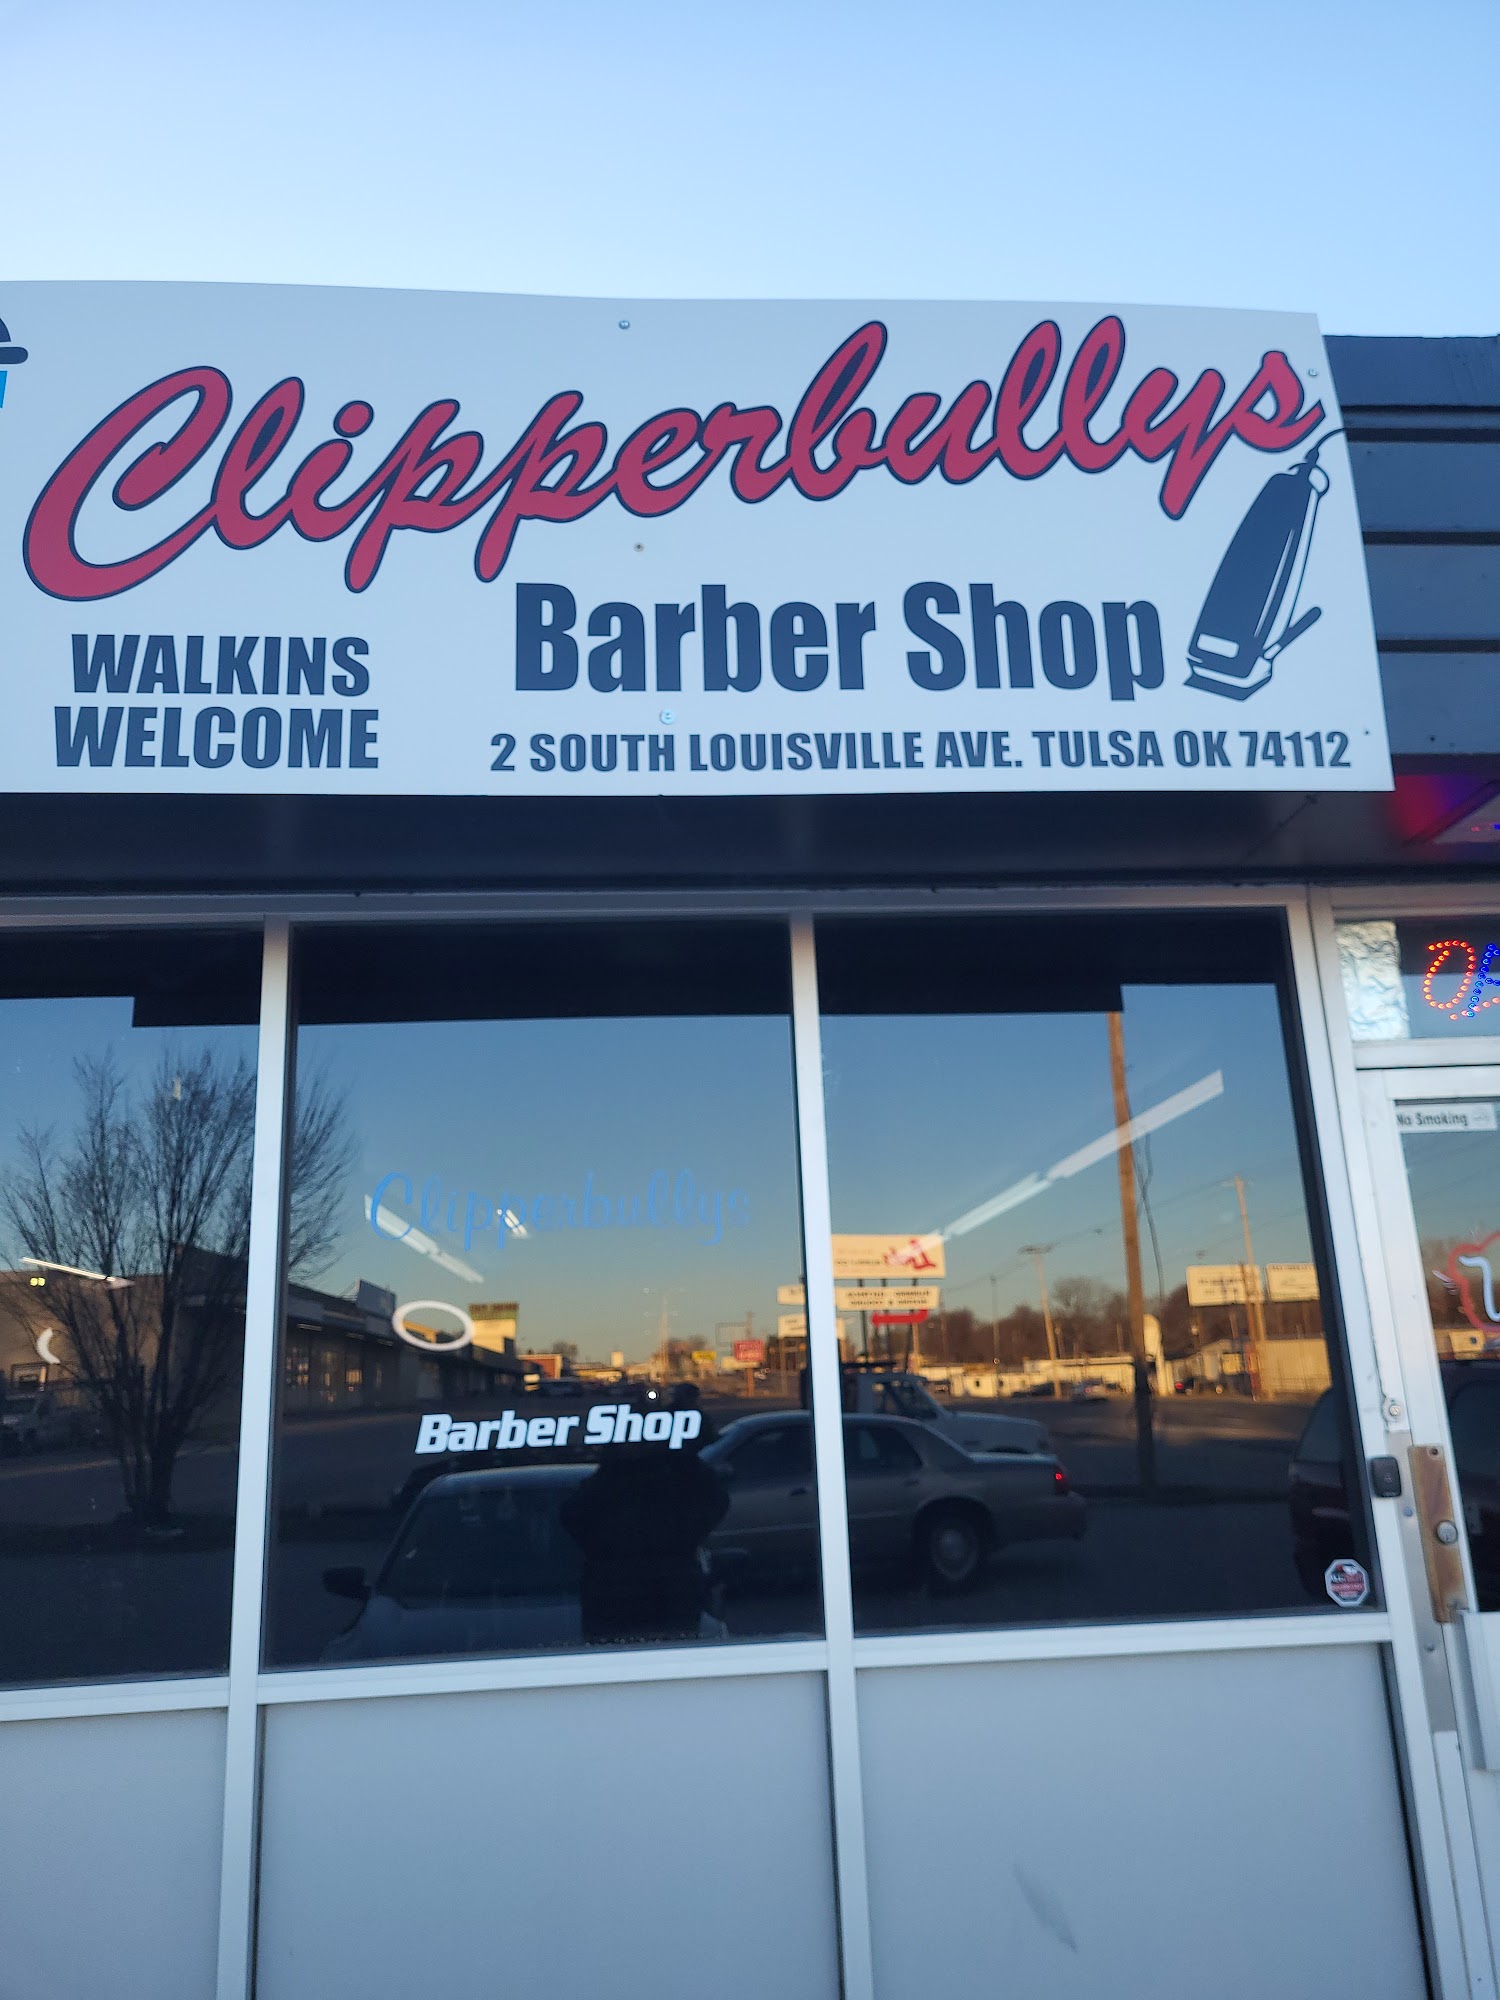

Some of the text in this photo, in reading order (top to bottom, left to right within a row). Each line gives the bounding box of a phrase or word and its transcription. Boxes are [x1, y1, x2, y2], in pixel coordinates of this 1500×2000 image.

[22, 315, 1326, 602] Clipperbullys
[71, 634, 371, 697] WALKINS
[514, 581, 1166, 701] Barber Shop
[54, 706, 379, 769] WELCOME
[490, 731, 1351, 772] 2 SOUTH LOUISVILLE AVE. TULSA OK 74112
[1415, 1112, 1469, 1127] Smoking
[371, 1169, 751, 1248] Clipperbullys
[415, 1404, 702, 1454] Barber Shop
